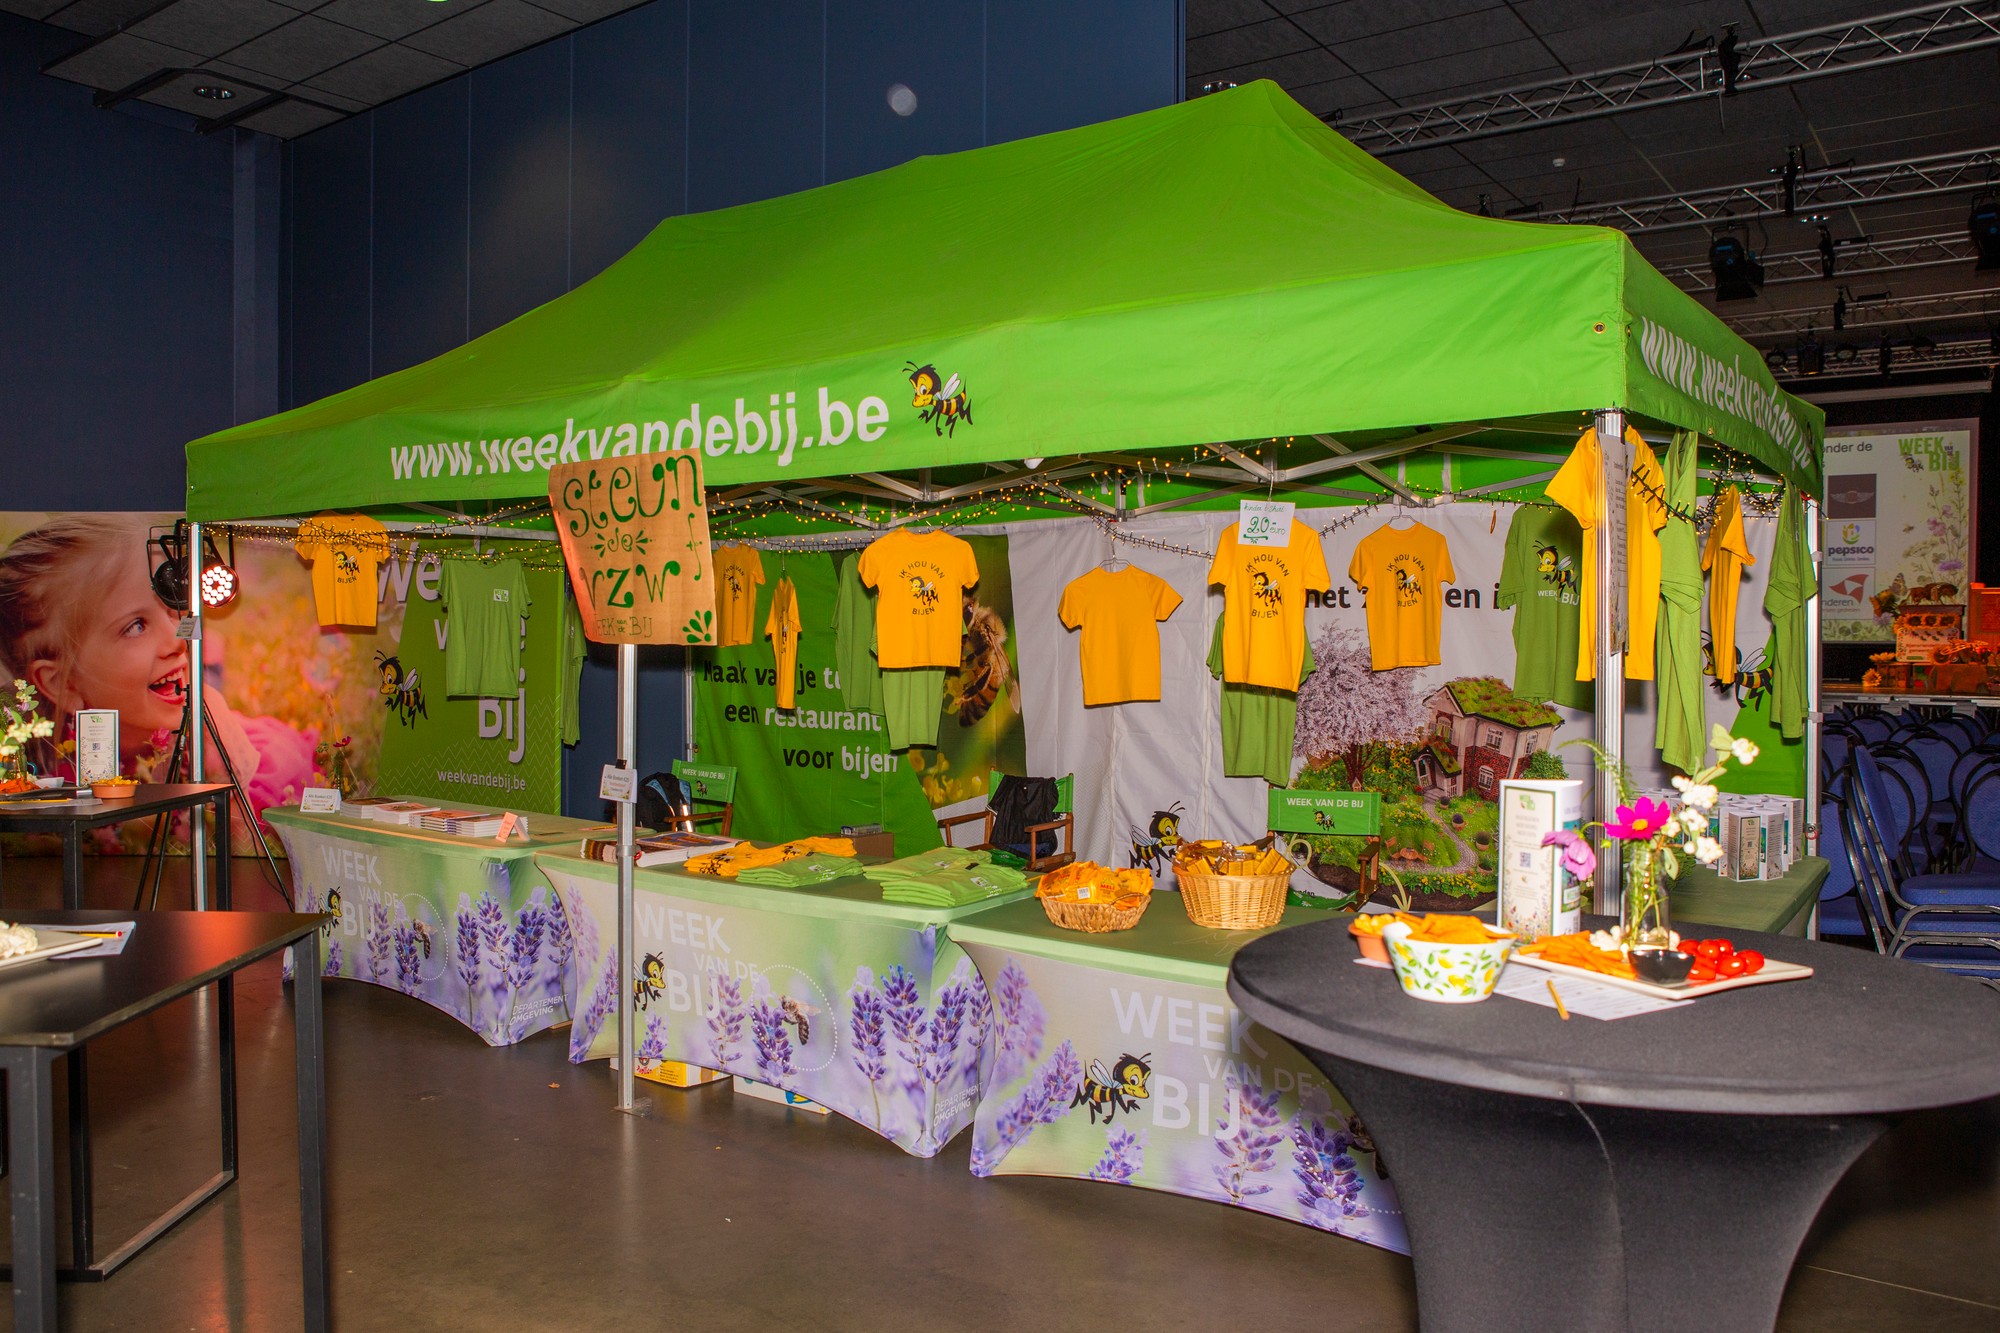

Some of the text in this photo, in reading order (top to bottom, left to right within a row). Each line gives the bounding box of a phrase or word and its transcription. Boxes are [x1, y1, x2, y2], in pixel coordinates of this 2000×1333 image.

[1857, 441, 1872, 452] de
[1898, 437, 1944, 456] WEEK
[1929, 450, 1960, 472] BIJ
[1270, 526, 1286, 536] euro
[1387, 554, 1425, 572] IK HOU VAN
[1828, 546, 1874, 557] pepsico
[899, 561, 945, 579] IK HOU VAN
[1254, 554, 1273, 564] HOU
[1276, 558, 1289, 577] VAN
[912, 606, 935, 615] BIJEN
[1561, 592, 1579, 606] BIJ
[1252, 609, 1279, 618] BIJEN
[629, 614, 653, 638] BIJ
[703, 660, 748, 685] Maak
[755, 667, 777, 686] va
[796, 663, 817, 695] je
[724, 703, 882, 732] een restaurant
[682, 768, 697, 776] WEEK
[698, 770, 709, 778] VAN
[783, 745, 898, 780] voor bijen
[437, 768, 527, 794] weekvandebij.be
[1286, 798, 1364, 808] WEEK VAN DE BIJ
[320, 844, 382, 886] WEEK
[359, 884, 399, 907] VAN DE
[343, 901, 376, 941] BIJ
[634, 903, 731, 955] WEEK
[692, 951, 761, 985] VAN DE
[512, 993, 569, 1016] DEPARTEMENT
[667, 969, 722, 1020] BIJ
[510, 1005, 554, 1026] OMGEVING
[1109, 987, 1268, 1060] WEEK
[1203, 1054, 1313, 1095] VAN DE
[935, 1081, 983, 1115] DEPARTEMENT
[1151, 1073, 1241, 1141] BIJ
[934, 1098, 971, 1128] OMGEVING
